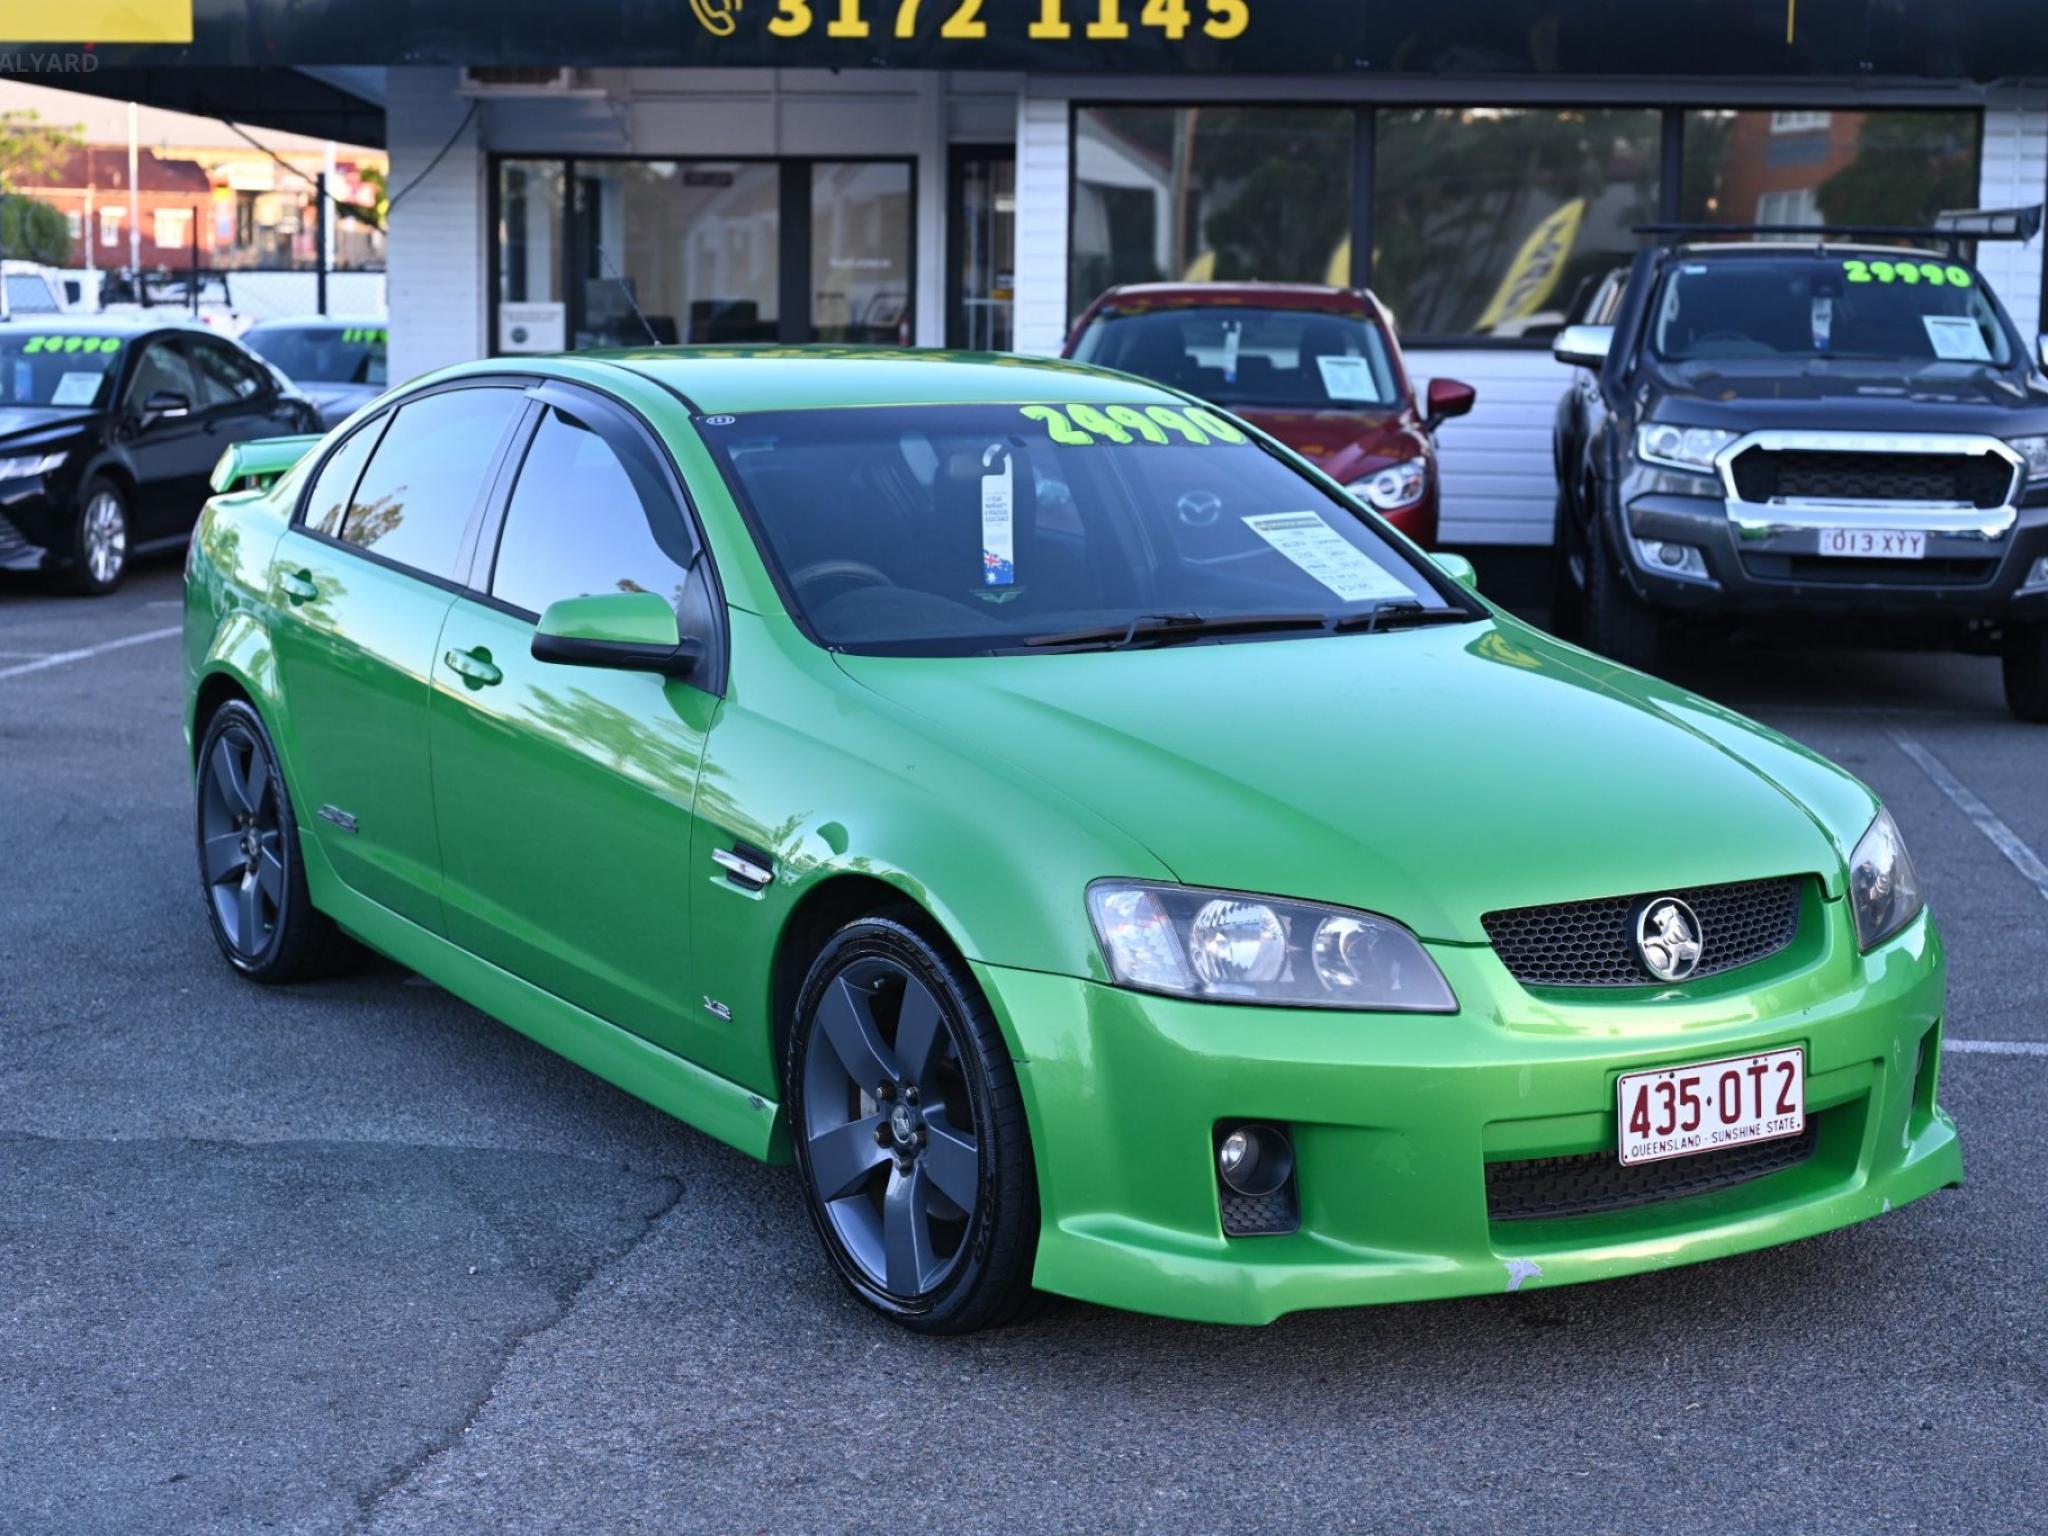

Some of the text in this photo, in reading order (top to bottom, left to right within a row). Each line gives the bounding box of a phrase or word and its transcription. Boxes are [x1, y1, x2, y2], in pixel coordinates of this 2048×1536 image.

[1842, 260, 1972, 288] 29990
[22, 335, 121, 354] 24990
[1019, 403, 1249, 446] 24990
[1882, 535, 1921, 555] XYY
[1631, 1134, 1701, 1158] QUEENSLAND
[1711, 1123, 1761, 1144] SUNSHINE
[1766, 1116, 1796, 1134] STATE
